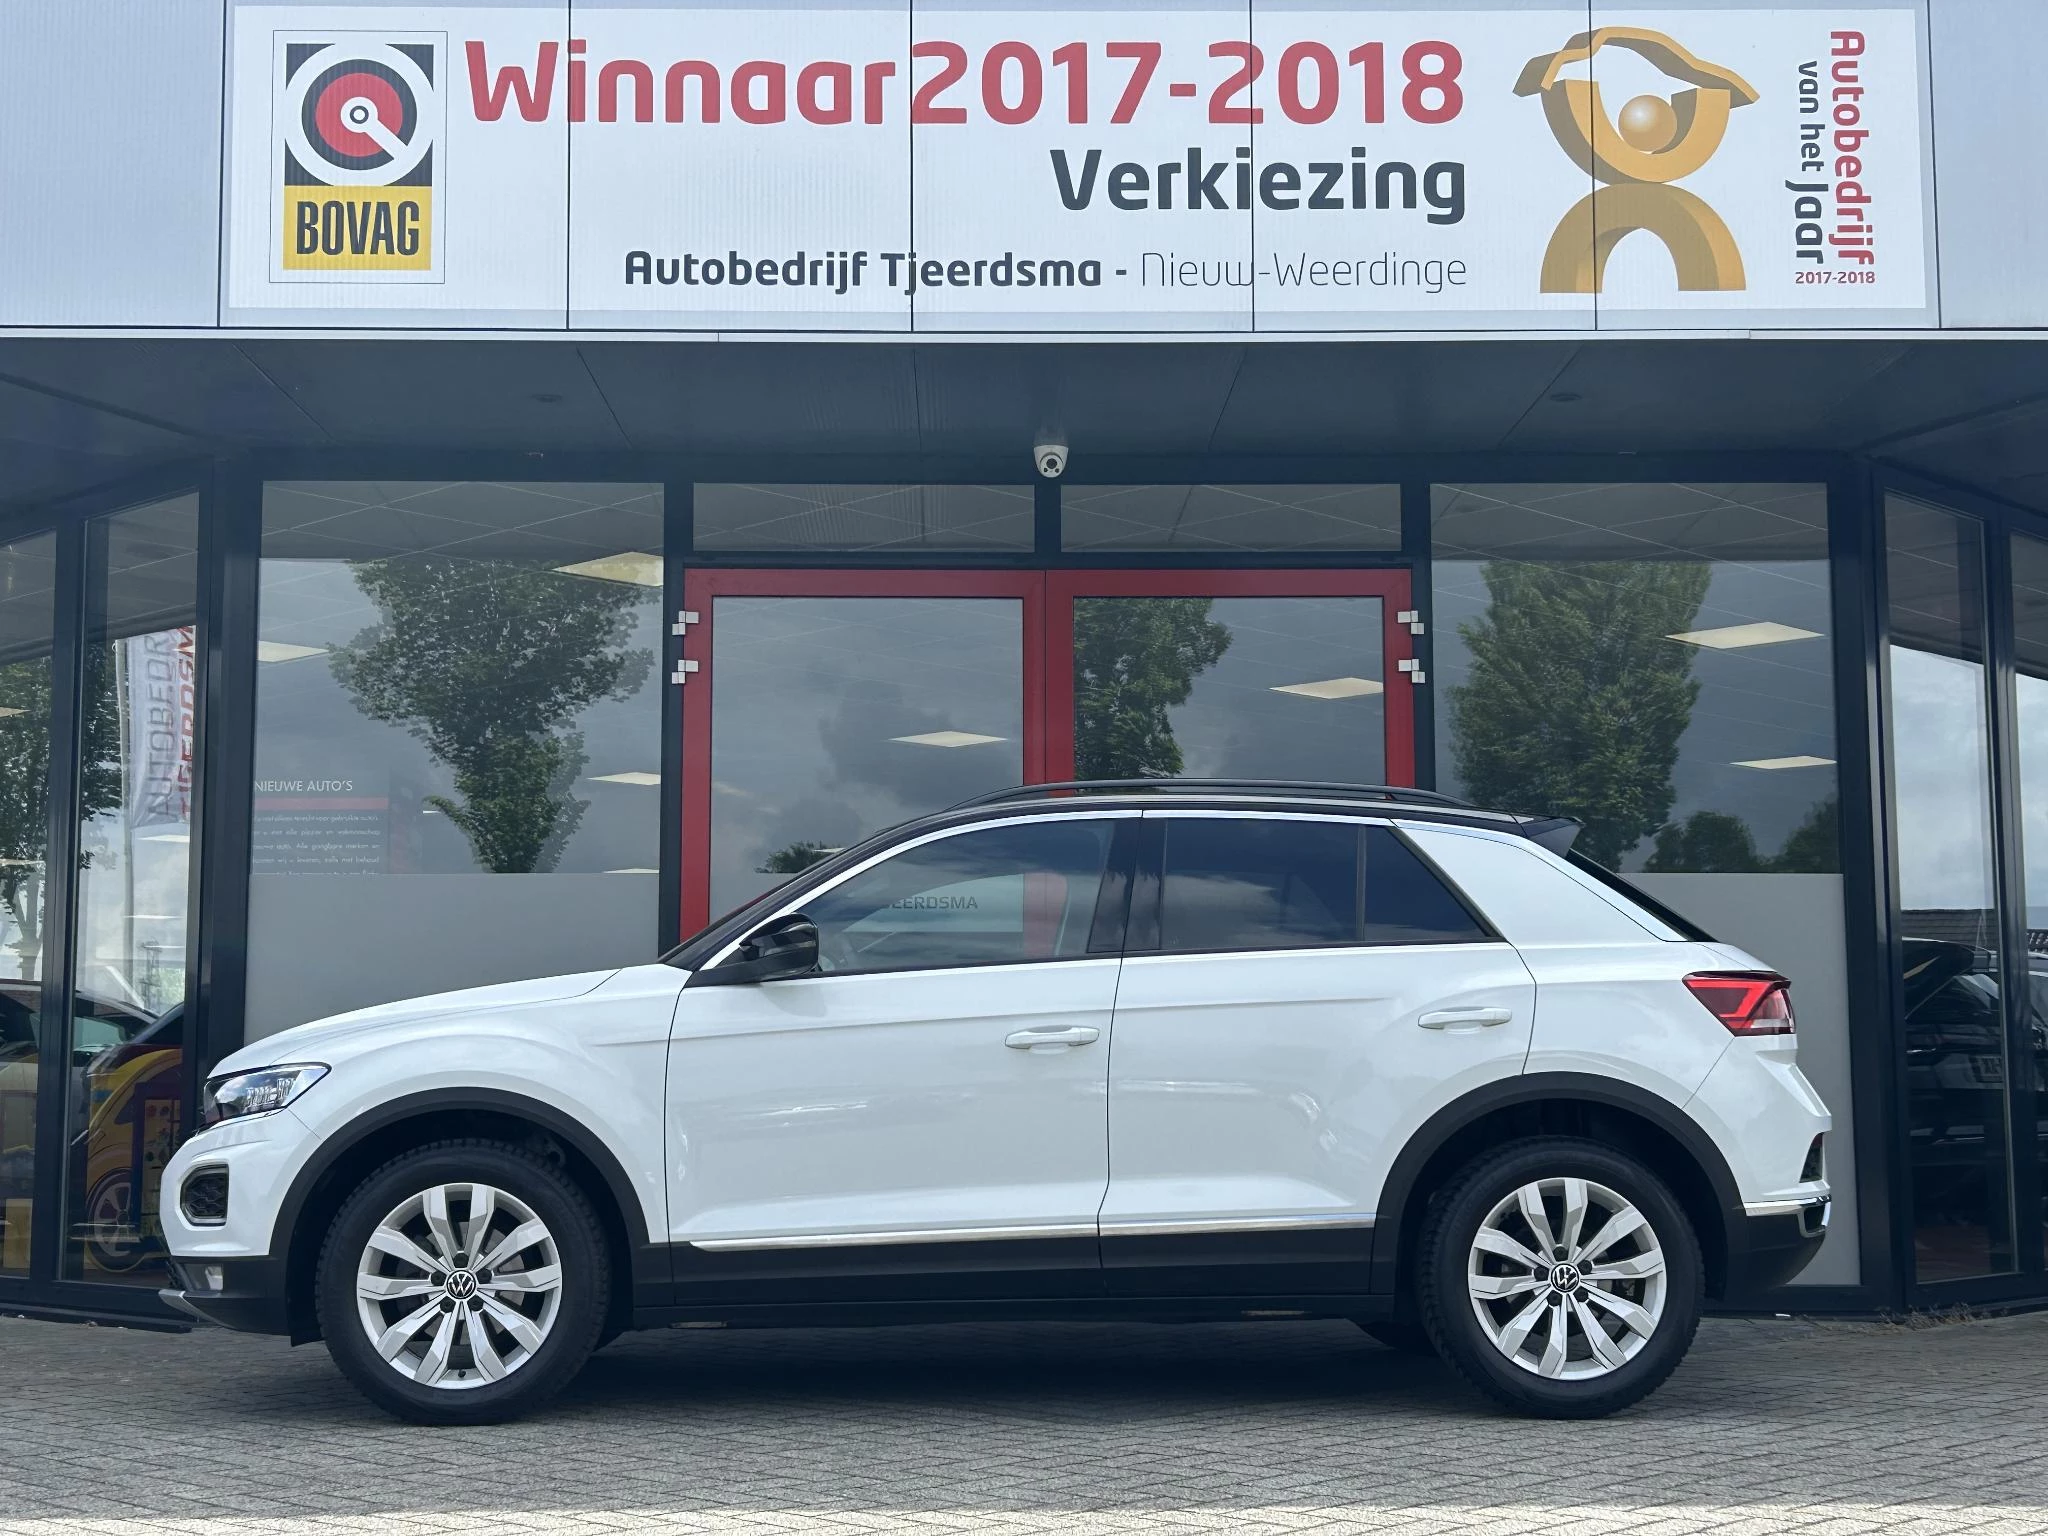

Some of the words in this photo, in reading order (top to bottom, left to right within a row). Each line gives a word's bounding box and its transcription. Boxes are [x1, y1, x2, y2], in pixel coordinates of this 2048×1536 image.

[464, 38, 896, 126] Winnaar
[911, 40, 1464, 126] 2017-2018
[1797, 60, 1819, 114] van
[1800, 123, 1826, 172] het
[1828, 30, 1876, 265] Autobedrijf
[1049, 146, 1466, 226] Verkiezing
[295, 200, 420, 256] BOVAG
[1784, 179, 1829, 264] Jaar
[624, 250, 869, 296] Autobedrijf
[880, 251, 1102, 296] Tjeerdsma
[1141, 251, 1467, 294] Nieuw-Weerdinge
[1795, 271, 1876, 285] 2017-2018
[254, 780, 303, 792] NIEUWE
[306, 779, 353, 792] AUTO'S
